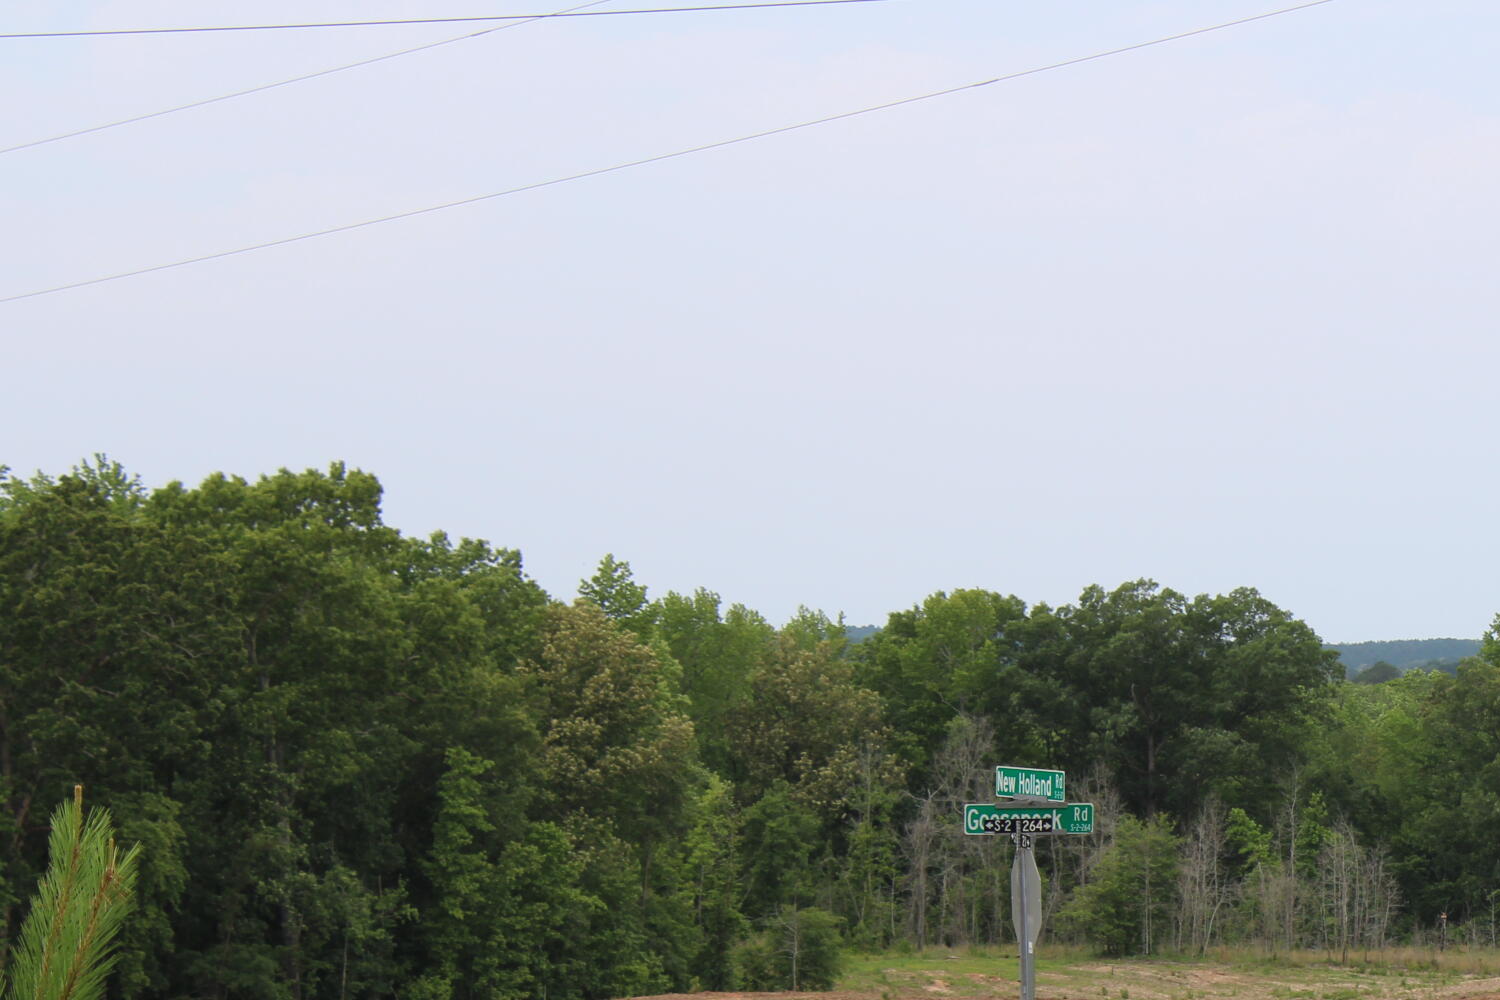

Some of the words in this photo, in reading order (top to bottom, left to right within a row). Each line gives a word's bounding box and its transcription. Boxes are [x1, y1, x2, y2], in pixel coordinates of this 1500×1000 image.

[997, 771, 1016, 793] New
[1019, 773, 1052, 796] Holland
[1055, 774, 1064, 789] Rd
[1074, 807, 1088, 822] Rd
[1022, 819, 1043, 832] 264
